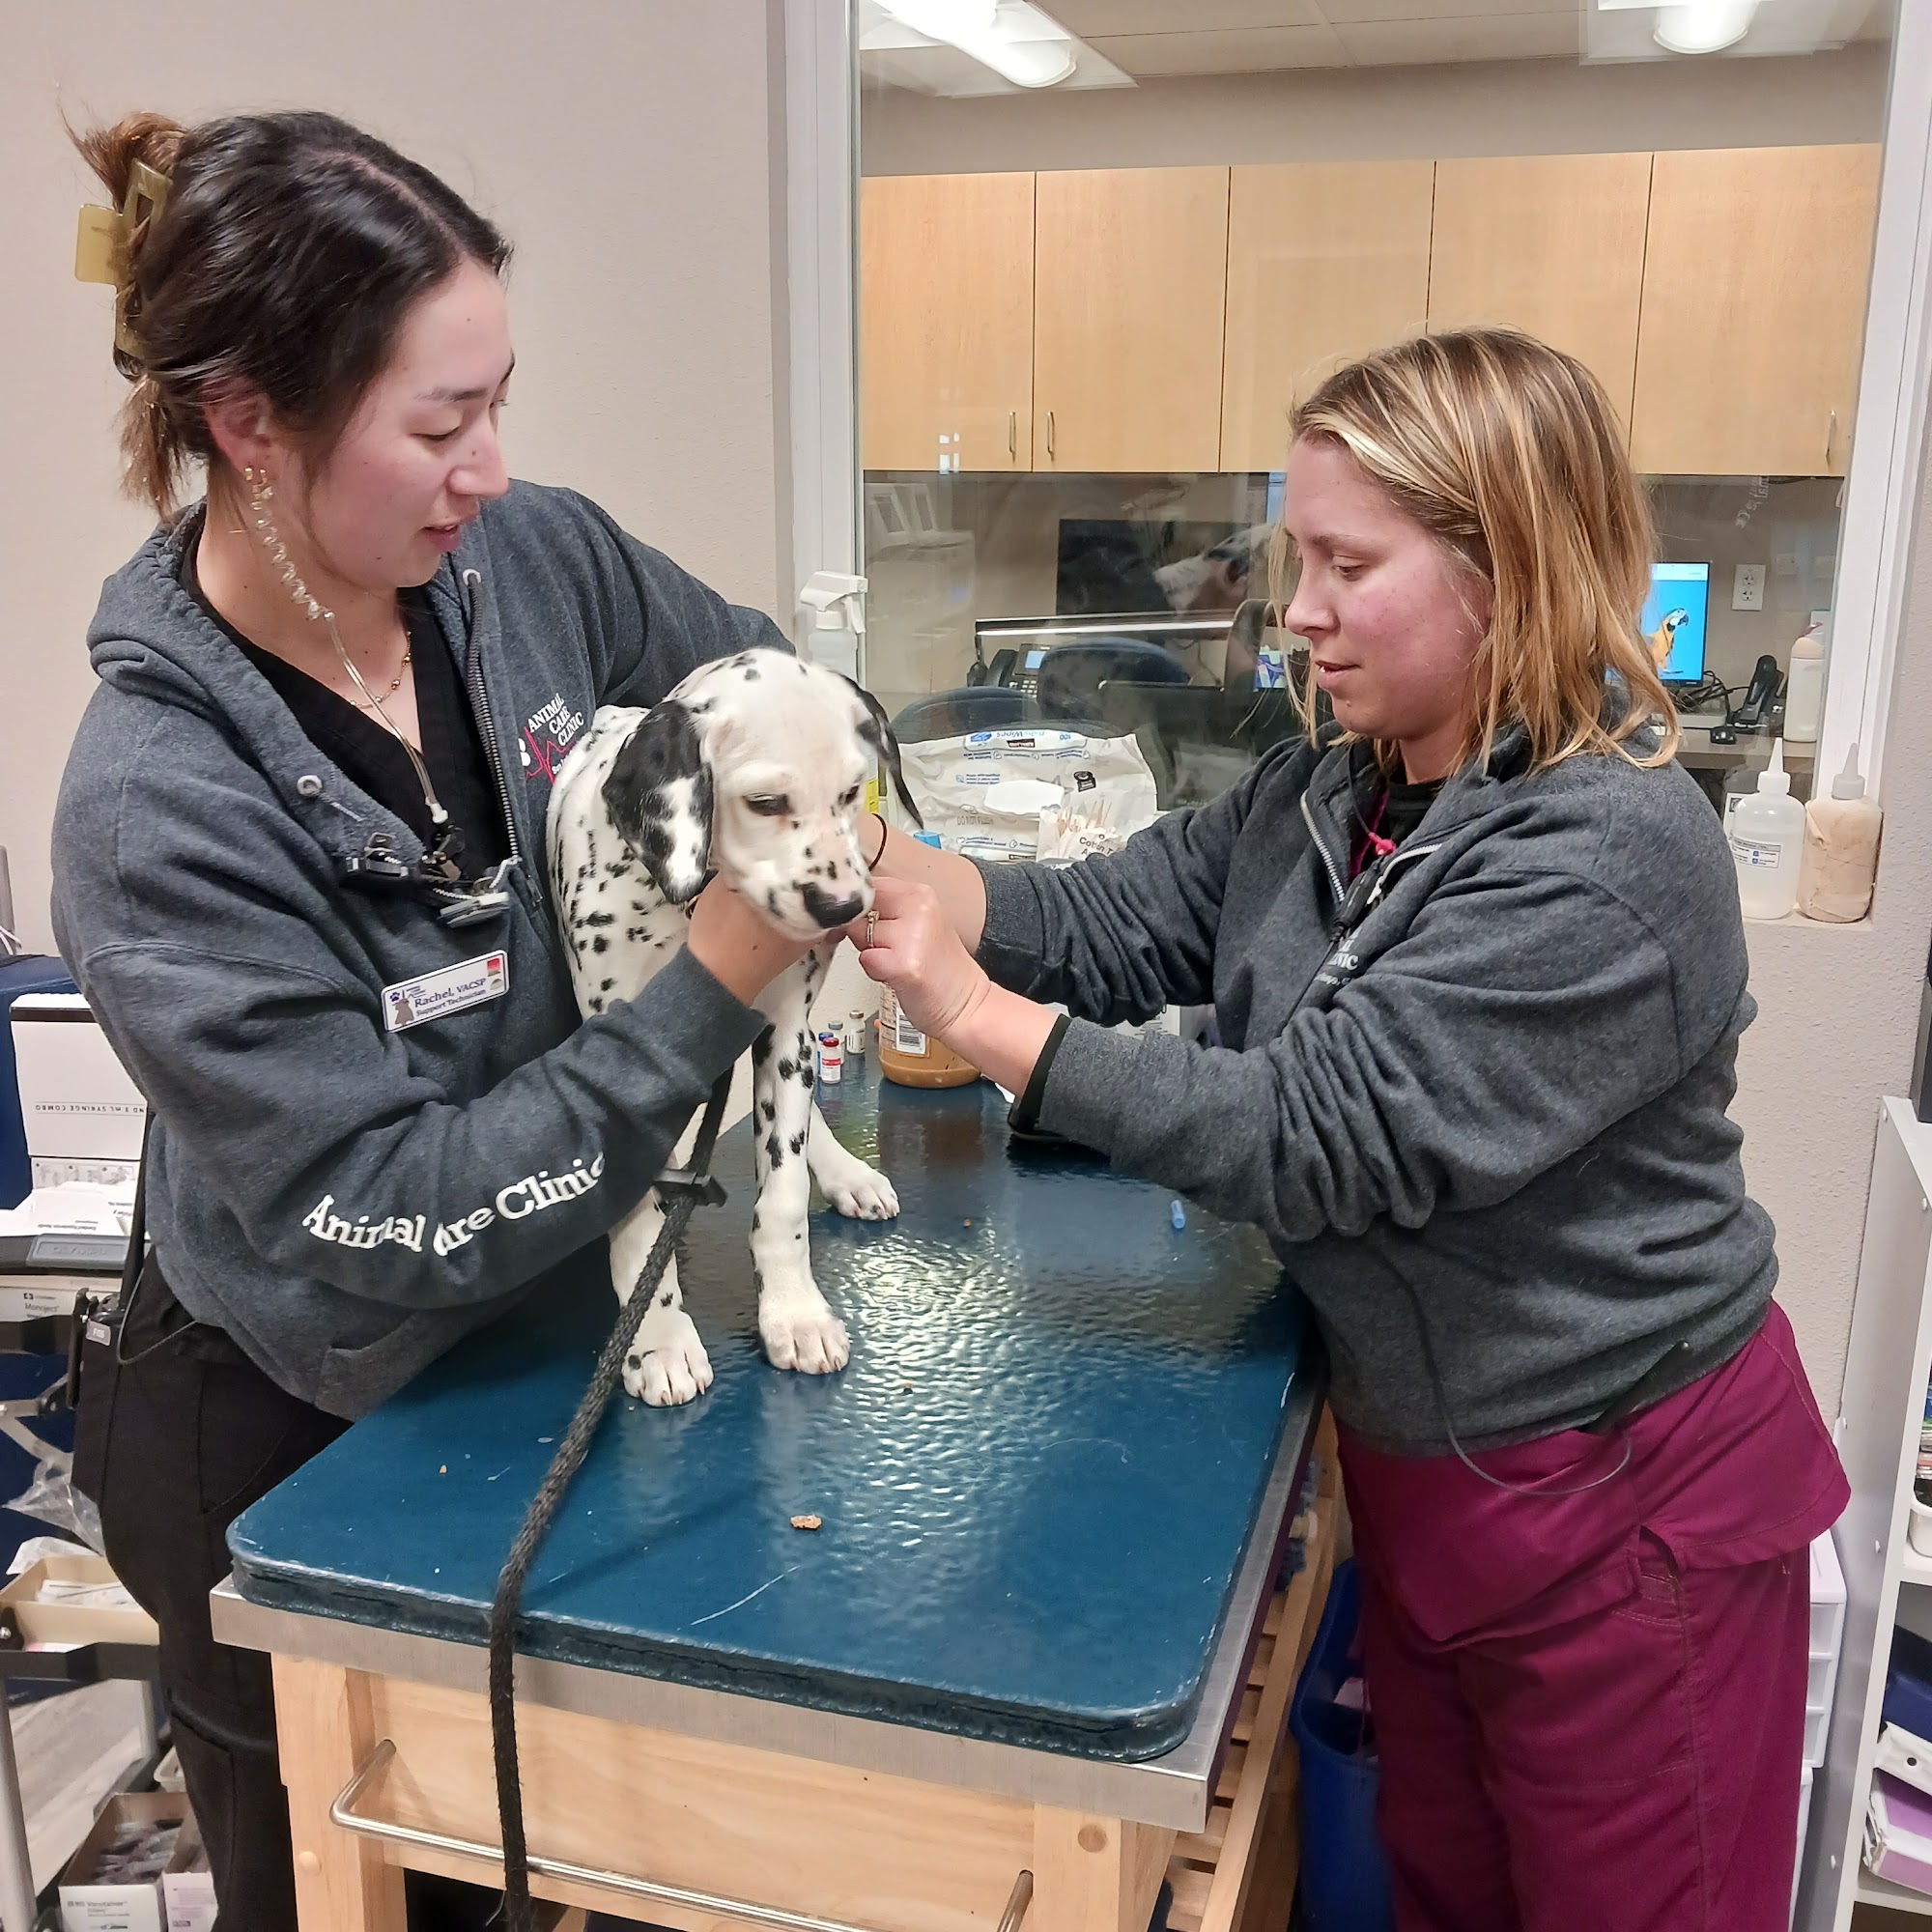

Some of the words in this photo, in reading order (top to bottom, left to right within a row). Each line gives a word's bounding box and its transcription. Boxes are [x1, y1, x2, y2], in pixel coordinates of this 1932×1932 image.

[557, 712, 584, 746] CLINIC
[414, 987, 455, 1008] Rachel,
[456, 978, 487, 993] VACSP
[416, 1002, 446, 1017] Support
[446, 989, 487, 1006] Technician
